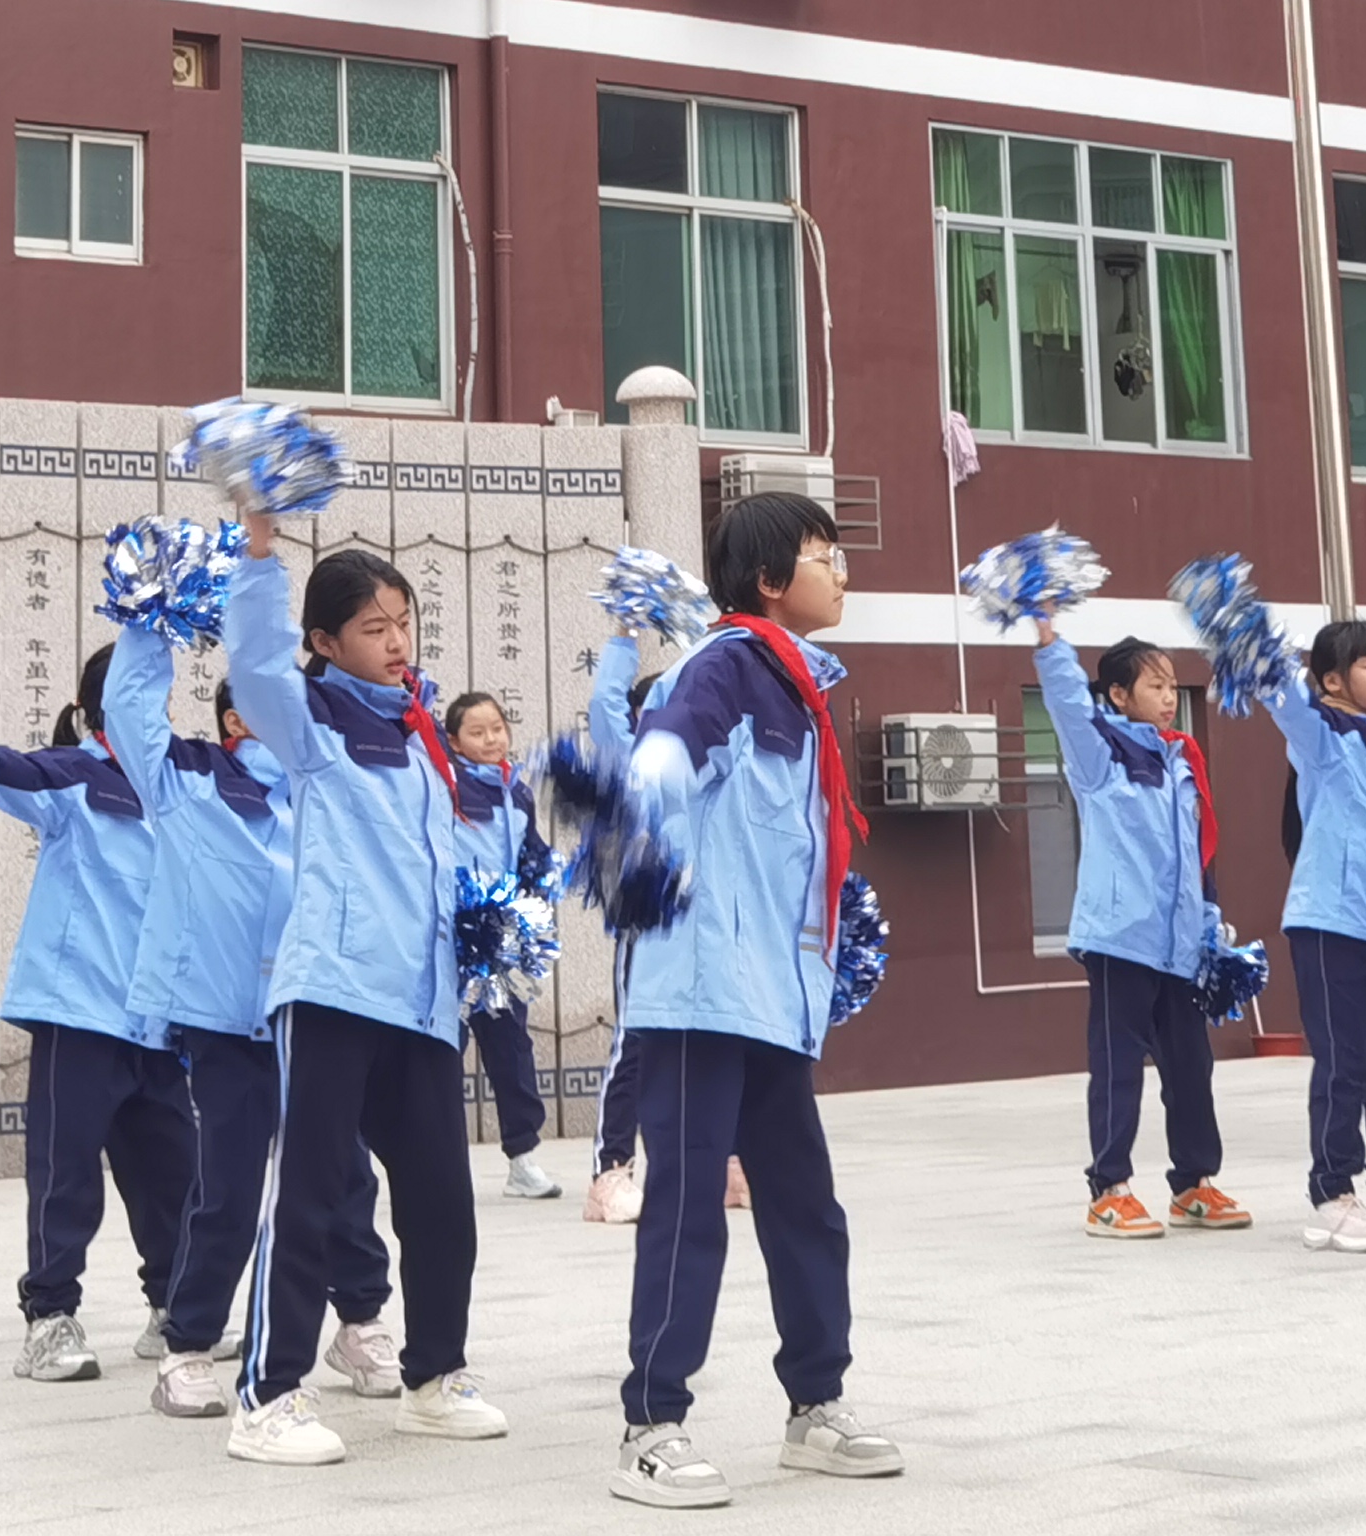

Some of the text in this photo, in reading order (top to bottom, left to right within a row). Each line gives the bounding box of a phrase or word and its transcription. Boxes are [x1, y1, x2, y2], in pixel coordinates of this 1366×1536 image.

[25, 548, 51, 611] 有德者
[419, 559, 445, 660] 父之所贵者
[496, 560, 522, 661] 君之所贵者
